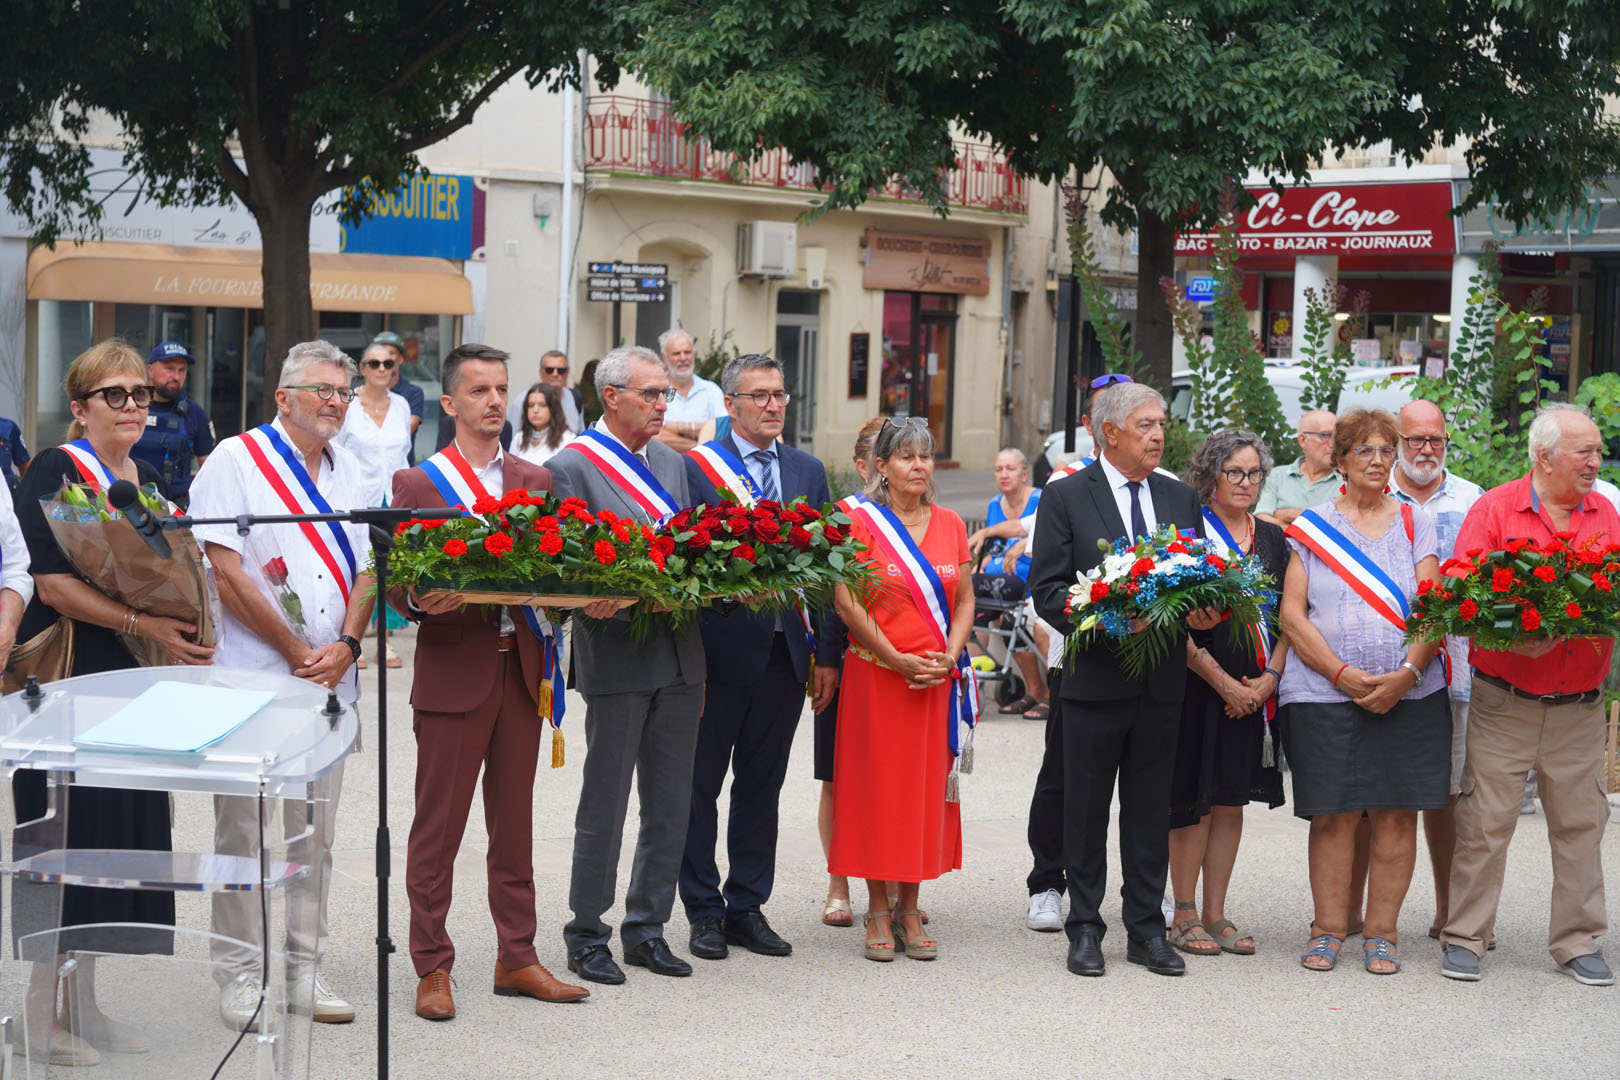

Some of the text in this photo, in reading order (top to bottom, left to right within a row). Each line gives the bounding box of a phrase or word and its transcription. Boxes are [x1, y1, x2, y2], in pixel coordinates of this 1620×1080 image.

[97, 223, 162, 240] ISCUITIER
[1174, 239, 1207, 251] BAC
[1273, 237, 1327, 250] BAZAR
[1340, 236, 1433, 250] JOURNAUX
[153, 276, 180, 293] LA
[187, 277, 263, 297] FOURNE
[1193, 280, 1211, 291] FDJ
